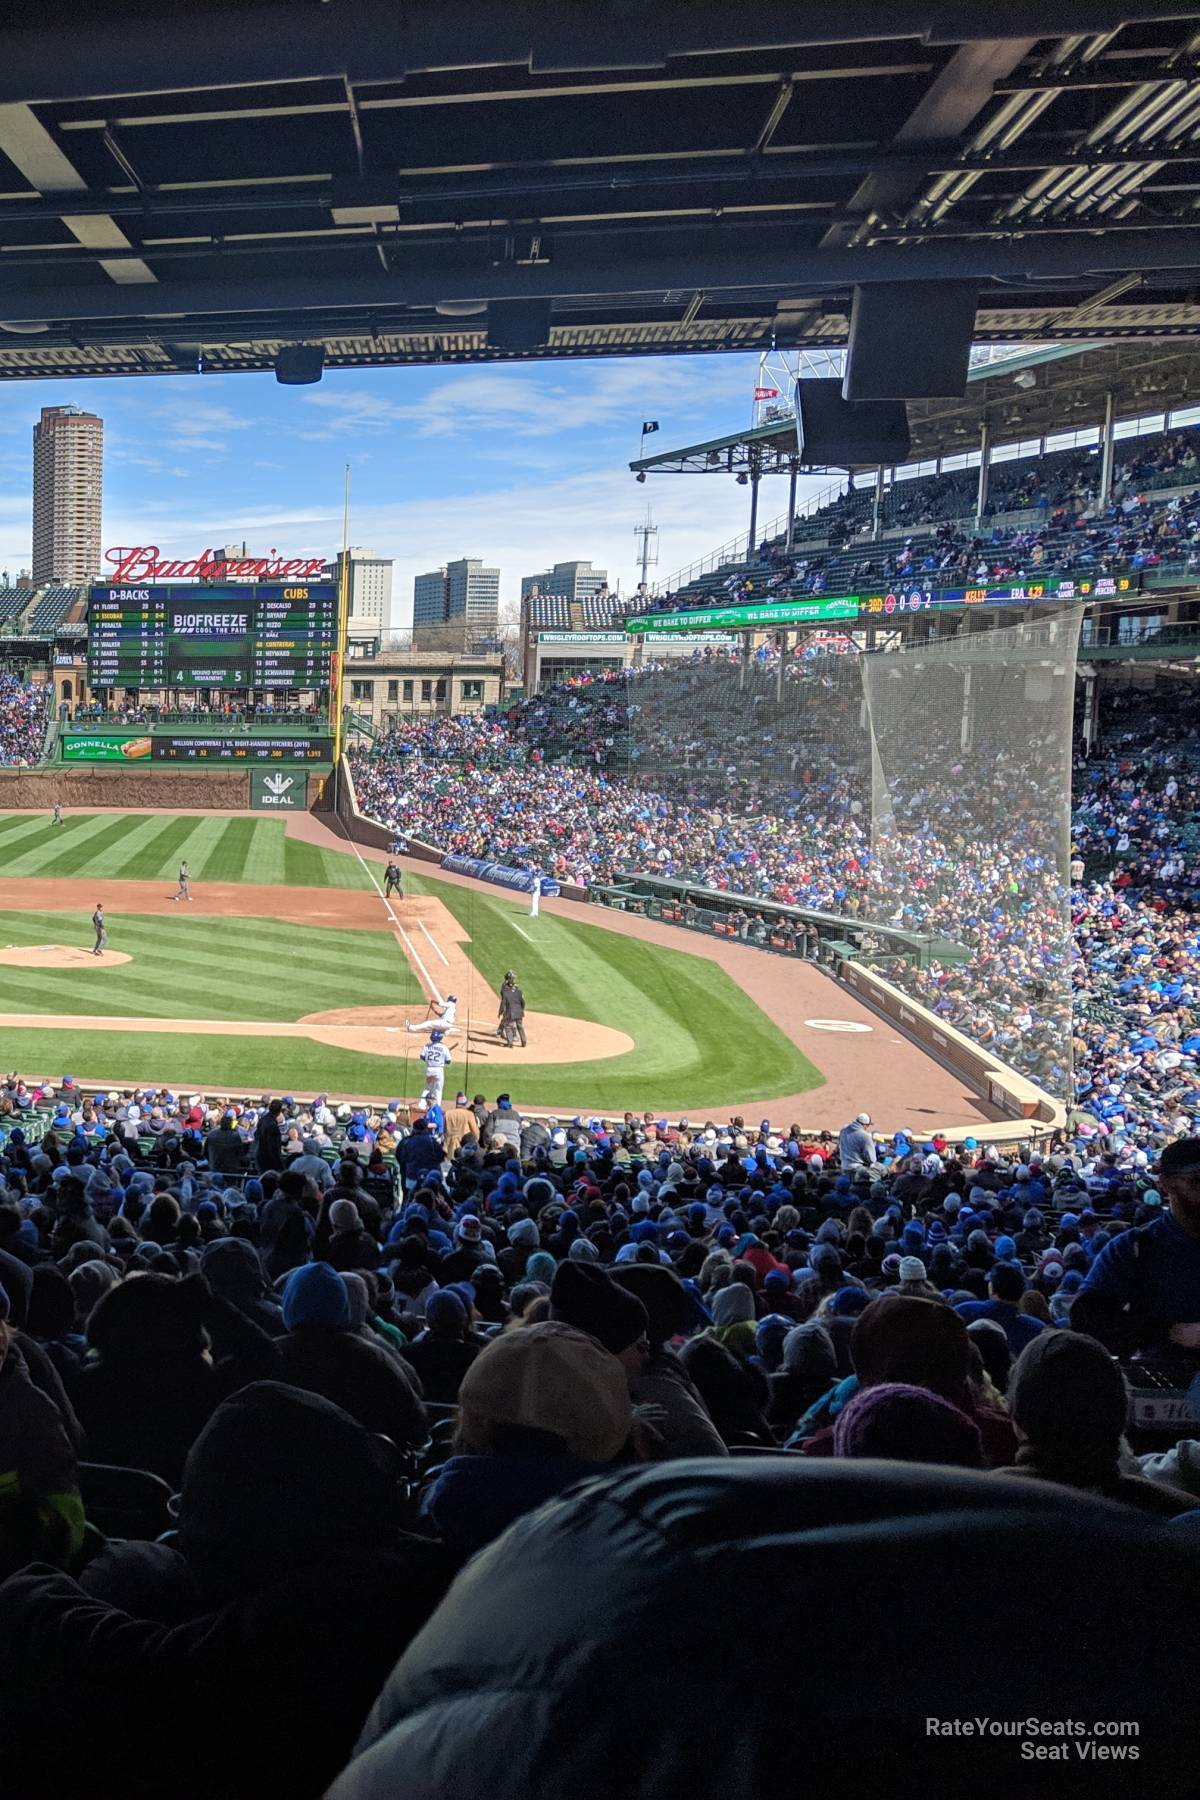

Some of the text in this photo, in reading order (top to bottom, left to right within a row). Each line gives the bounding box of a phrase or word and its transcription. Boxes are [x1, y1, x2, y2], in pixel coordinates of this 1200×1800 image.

[105, 546, 326, 583] Budweiser
[1060, 582, 1074, 590] PITCH
[1098, 578, 1114, 587] STRIKE
[110, 590, 149, 600] D-BACKS
[284, 589, 309, 599] CUBS
[965, 590, 986, 603] KELLY
[1011, 588, 1024, 599] ERA
[1095, 587, 1116, 596] PERCENT
[868, 598, 882, 612] 3RD
[900, 594, 905, 610] 0
[925, 593, 931, 608] 2
[760, 610, 778, 619] BAKE
[781, 609, 790, 617] TO
[792, 606, 820, 616] DIFFER
[653, 619, 663, 627] WE
[680, 618, 687, 626] TO
[688, 616, 711, 625] DIFFER
[177, 670, 184, 681] 4
[234, 671, 241, 681] 5
[66, 741, 119, 751] GONNELLA
[262, 796, 294, 804] IDEAL
[428, 1051, 440, 1062] 22
